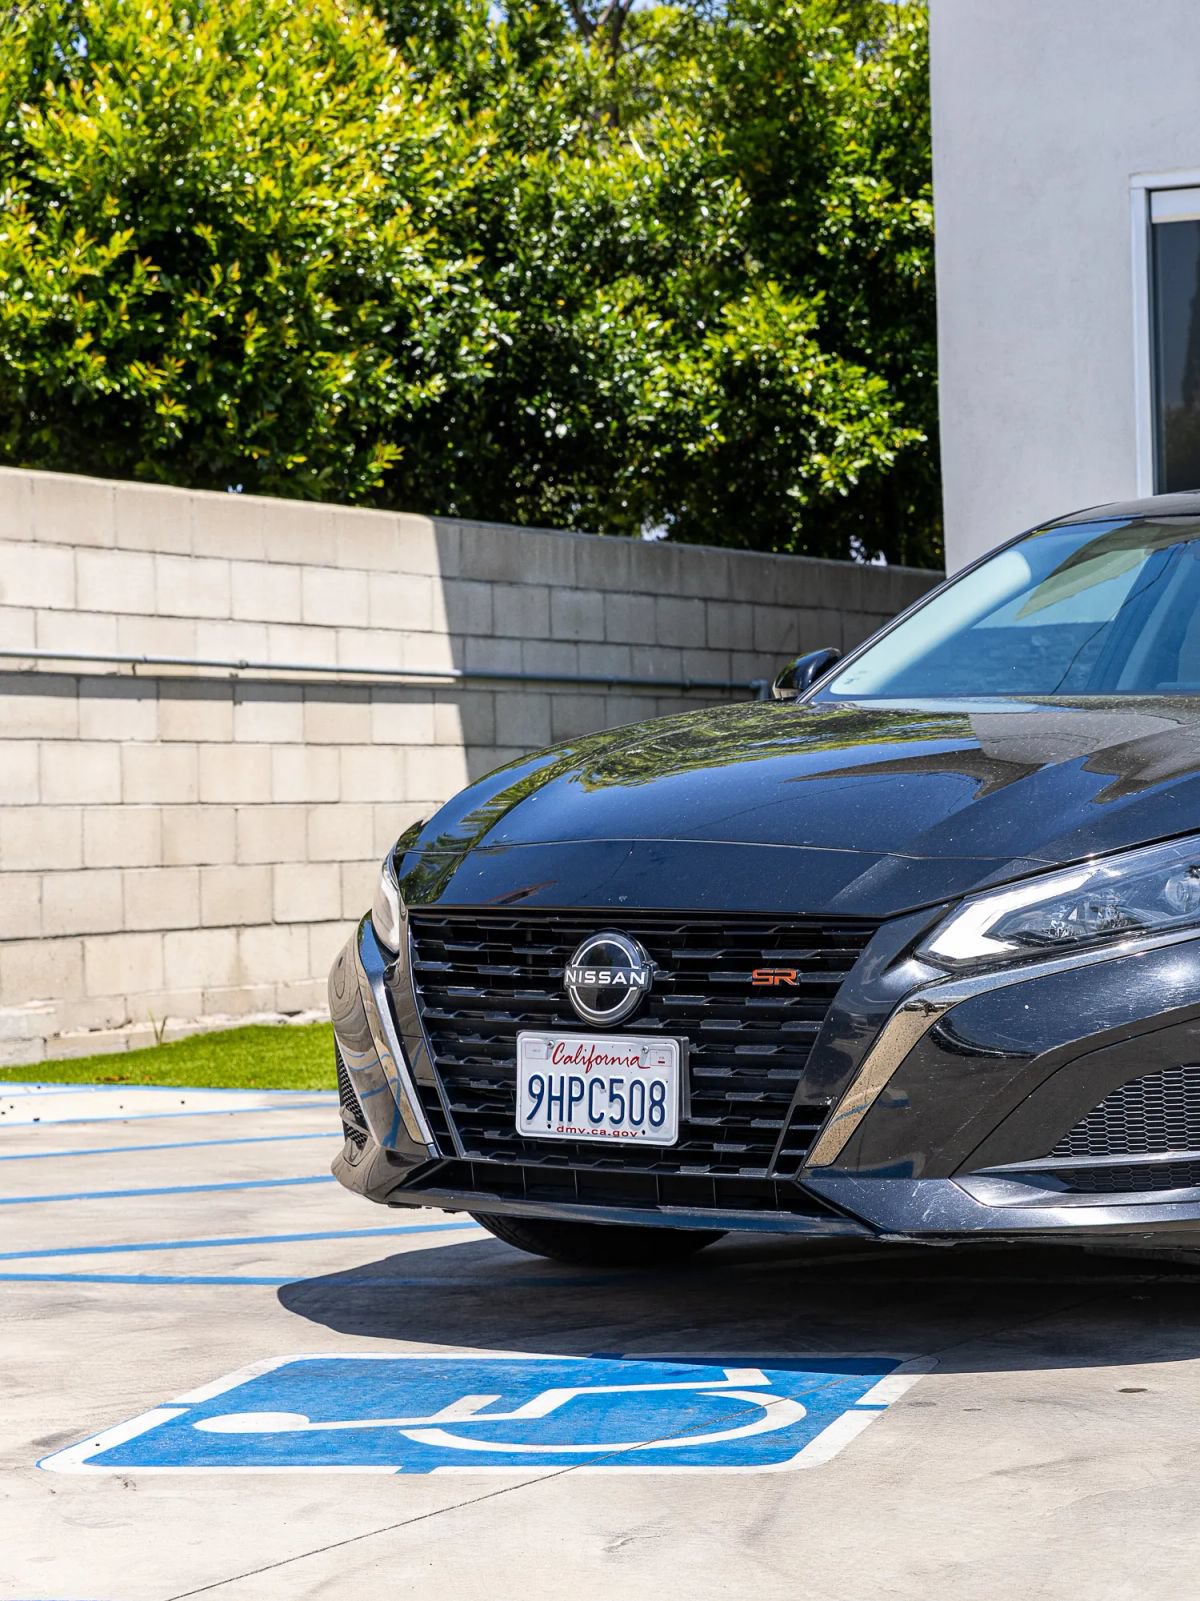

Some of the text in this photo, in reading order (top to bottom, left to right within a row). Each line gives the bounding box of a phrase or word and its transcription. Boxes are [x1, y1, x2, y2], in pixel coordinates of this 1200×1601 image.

[564, 969, 648, 986] NISSAN
[752, 968, 801, 986] SR
[552, 1041, 651, 1074] California
[526, 1073, 666, 1128] 9HPC508
[556, 1126, 638, 1138] dmv.ca.gov
